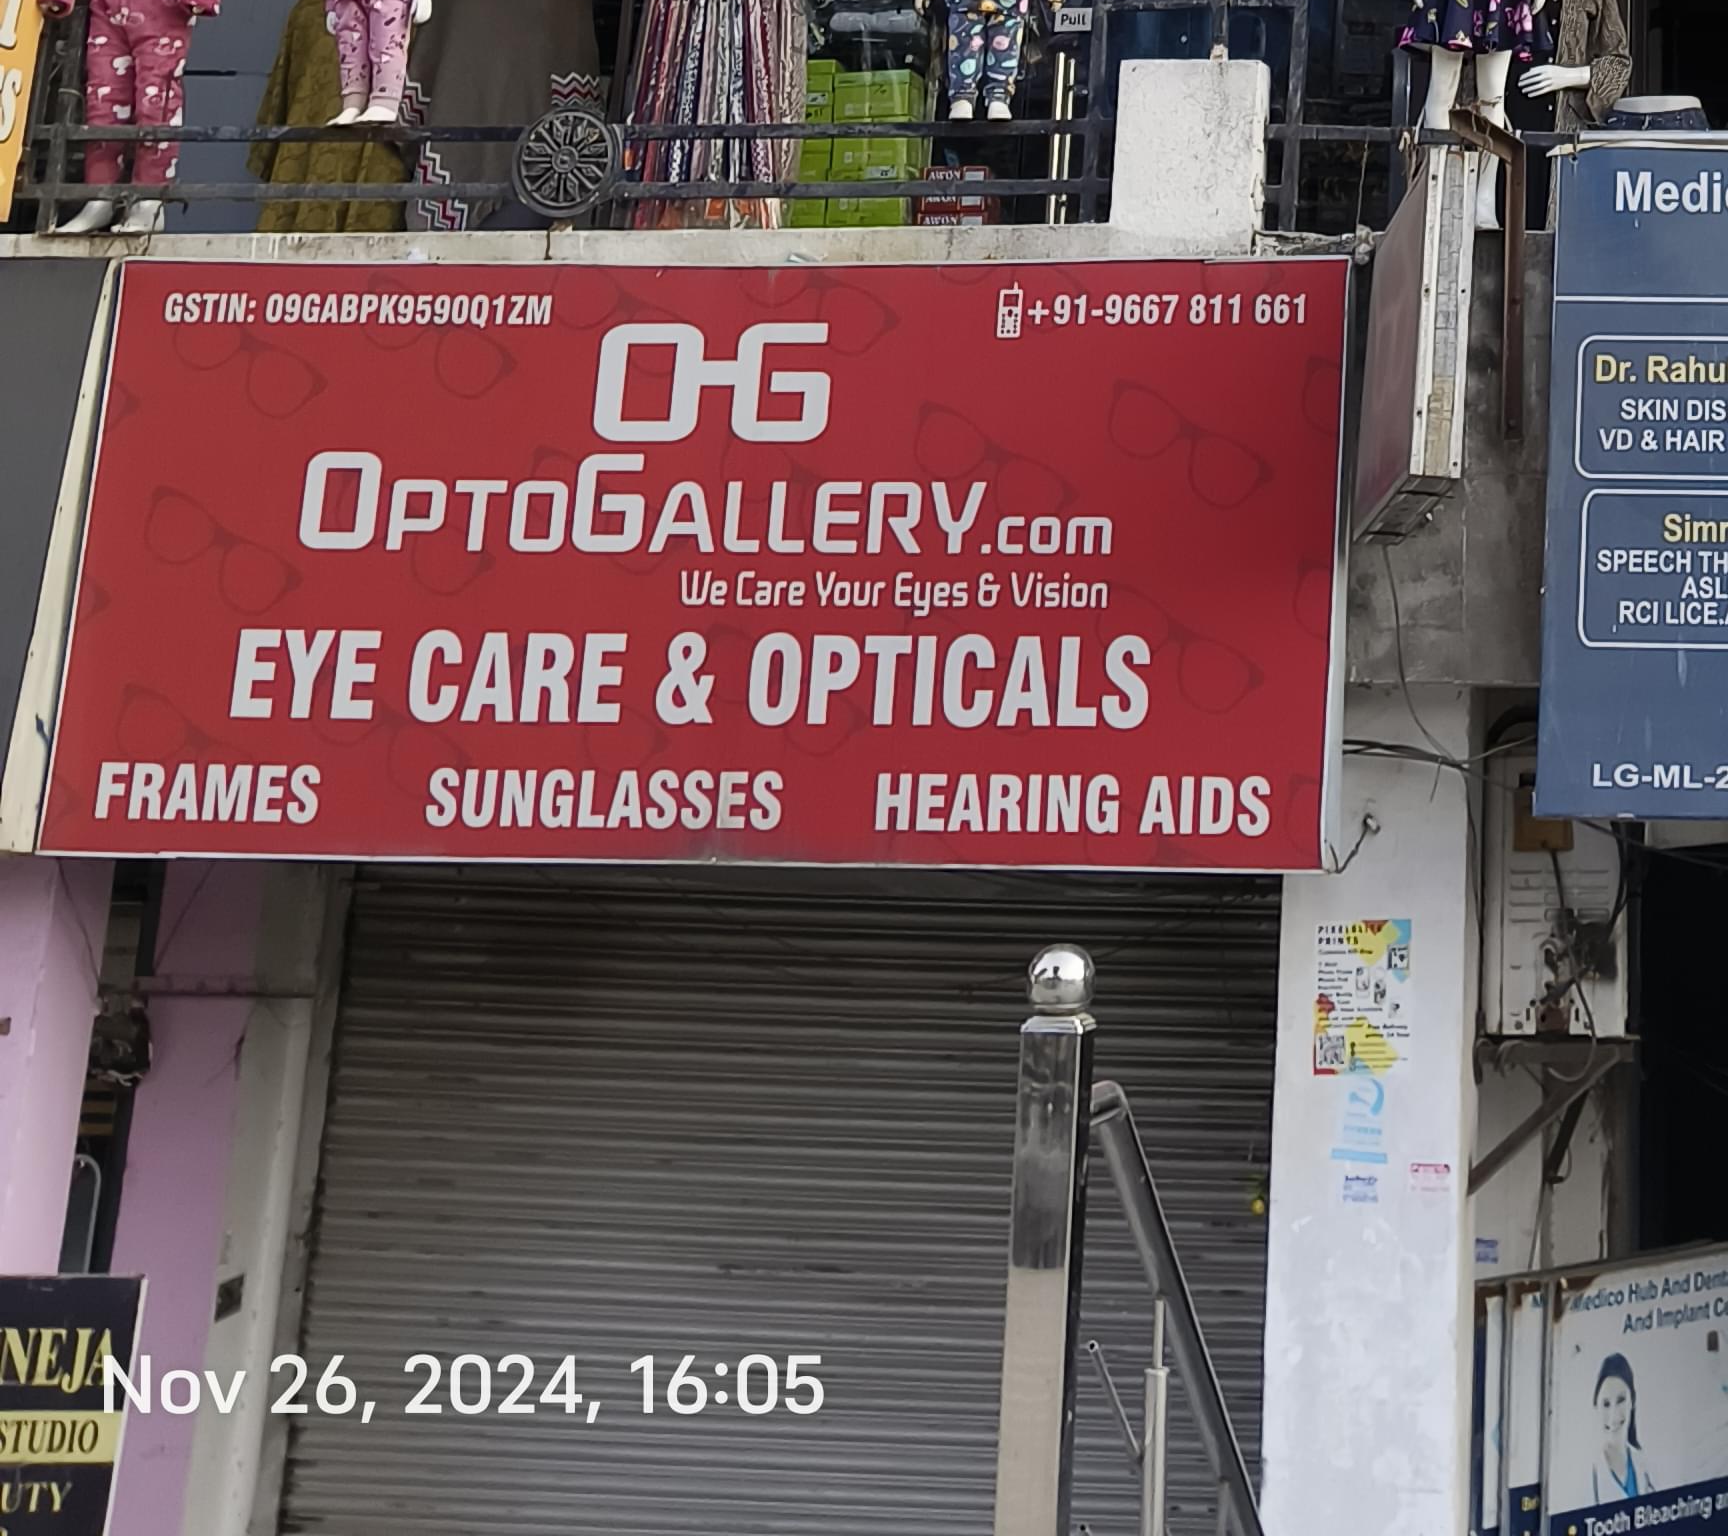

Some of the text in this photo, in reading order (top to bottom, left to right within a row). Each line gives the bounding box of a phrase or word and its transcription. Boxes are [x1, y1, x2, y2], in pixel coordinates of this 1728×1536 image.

[1060, 13, 1086, 26] Pull
[164, 293, 257, 323] GSTIN:
[1595, 355, 1636, 383] Dr.
[1620, 399, 1679, 421] SKIN
[680, 571, 1108, 617] We Care Your Eyes & Vision
[229, 629, 1150, 729] EYE CARE & OPTICALS
[94, 762, 1271, 837] FRAMES SUNGLASSES HEARING AIDS
